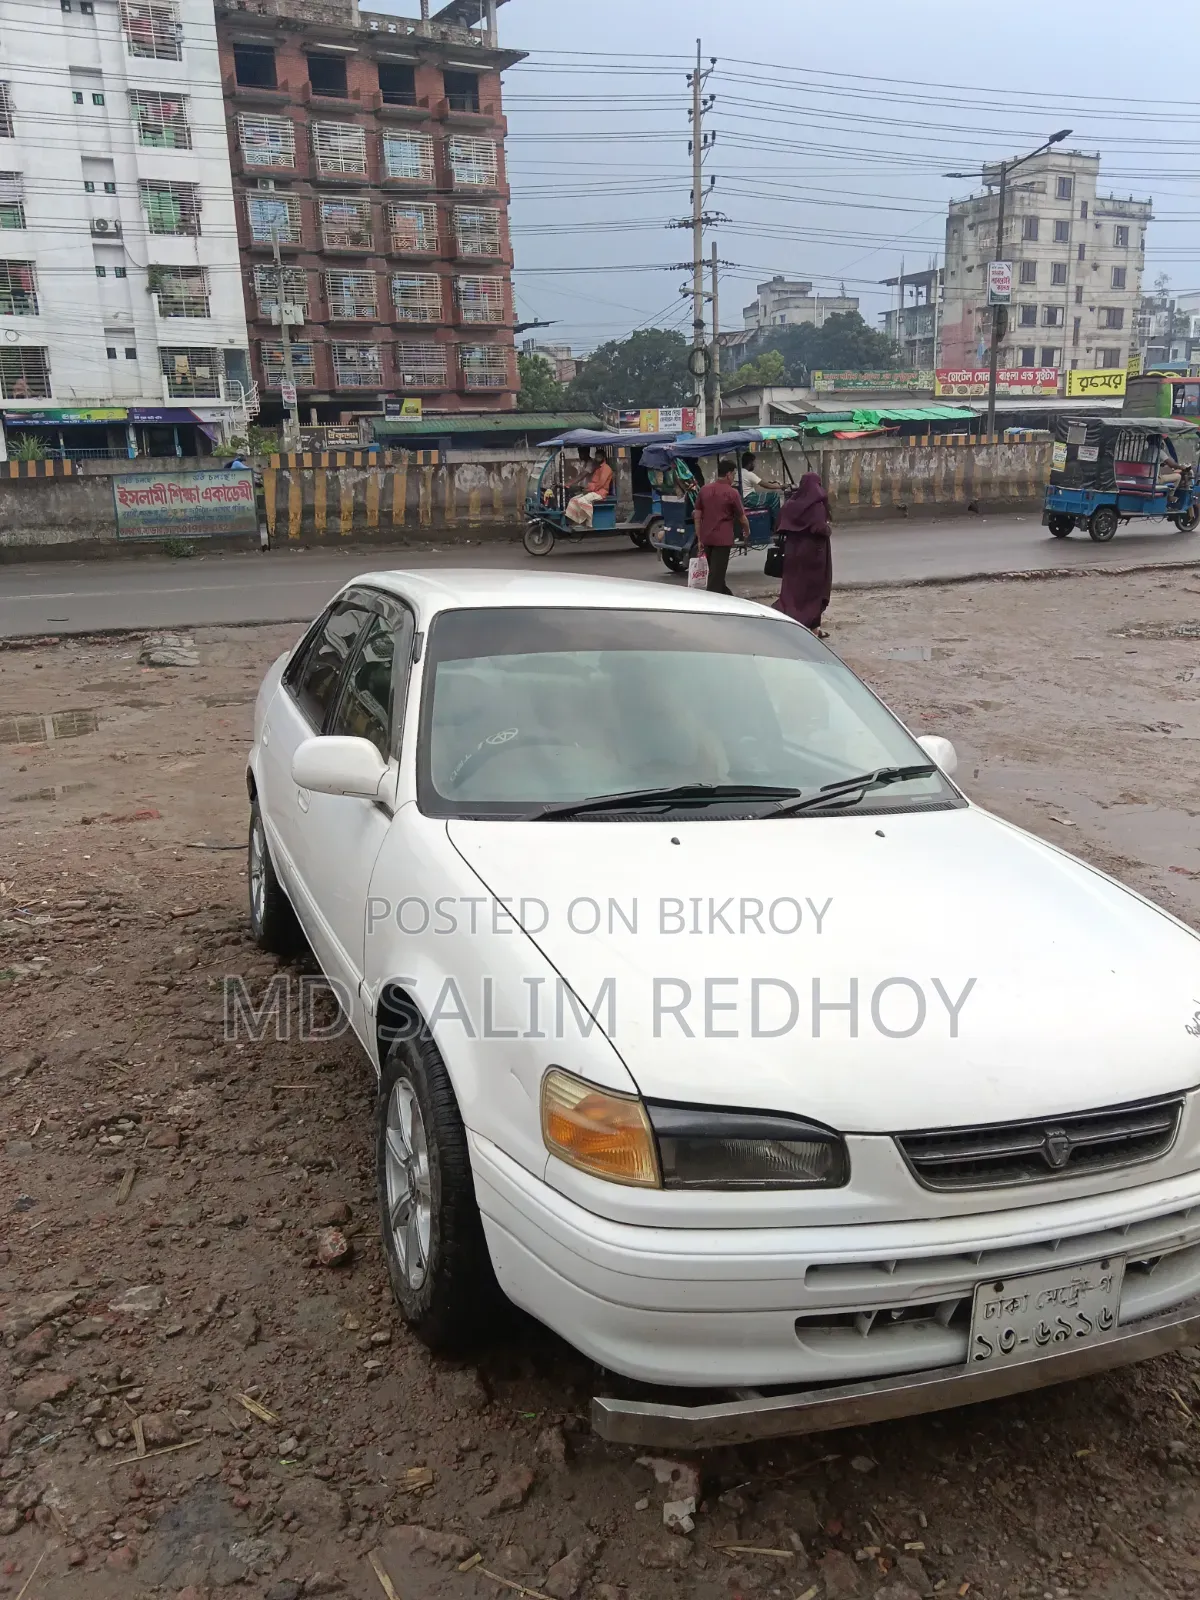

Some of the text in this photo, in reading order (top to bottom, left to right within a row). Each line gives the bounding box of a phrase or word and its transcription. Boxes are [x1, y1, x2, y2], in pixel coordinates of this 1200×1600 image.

[948, 369, 972, 382] হোটেল
[974, 371, 996, 382] সোন
[1000, 371, 1018, 381] বাংলা
[117, 480, 253, 508] ইসলামী শিক্ষা একাডেমী
[984, 1293, 1029, 1319] ঢাকা
[973, 1305, 1113, 1361] ১৩-৬৯১৬
